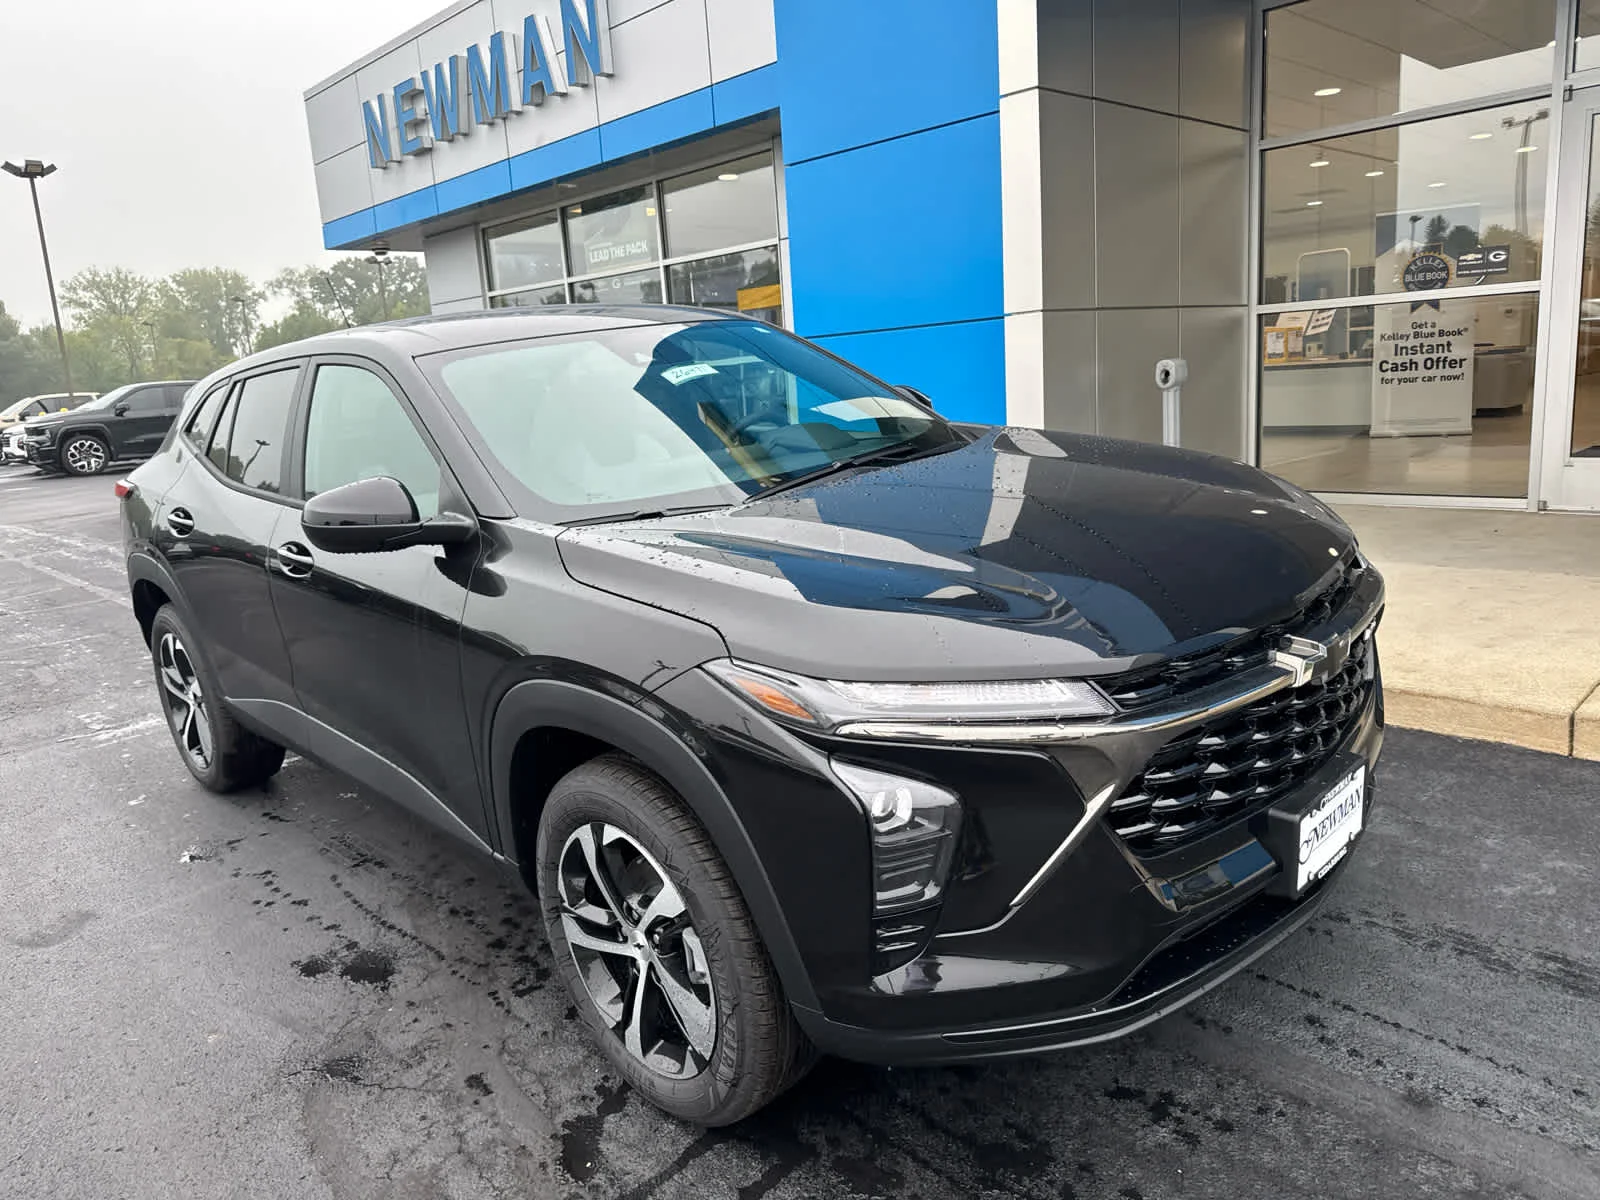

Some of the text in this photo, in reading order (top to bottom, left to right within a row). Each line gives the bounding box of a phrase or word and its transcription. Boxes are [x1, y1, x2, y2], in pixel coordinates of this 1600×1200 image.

[362, 0, 614, 169] NEWMAN
[590, 248, 609, 264] LEAD
[610, 245, 625, 259] THE
[626, 239, 648, 256] PACK
[1409, 257, 1446, 271] KELLEY
[1404, 272, 1425, 282] BLUE
[1425, 270, 1448, 281] BOOK
[1411, 321, 1428, 330] Get
[1380, 332, 1411, 342] Kelley
[1413, 330, 1436, 340] Blue
[1394, 340, 1452, 357] Instant
[1379, 356, 1467, 373] Cash Offer
[1380, 372, 1465, 385] for your car now!
[1299, 785, 1363, 865] NEWMAN
